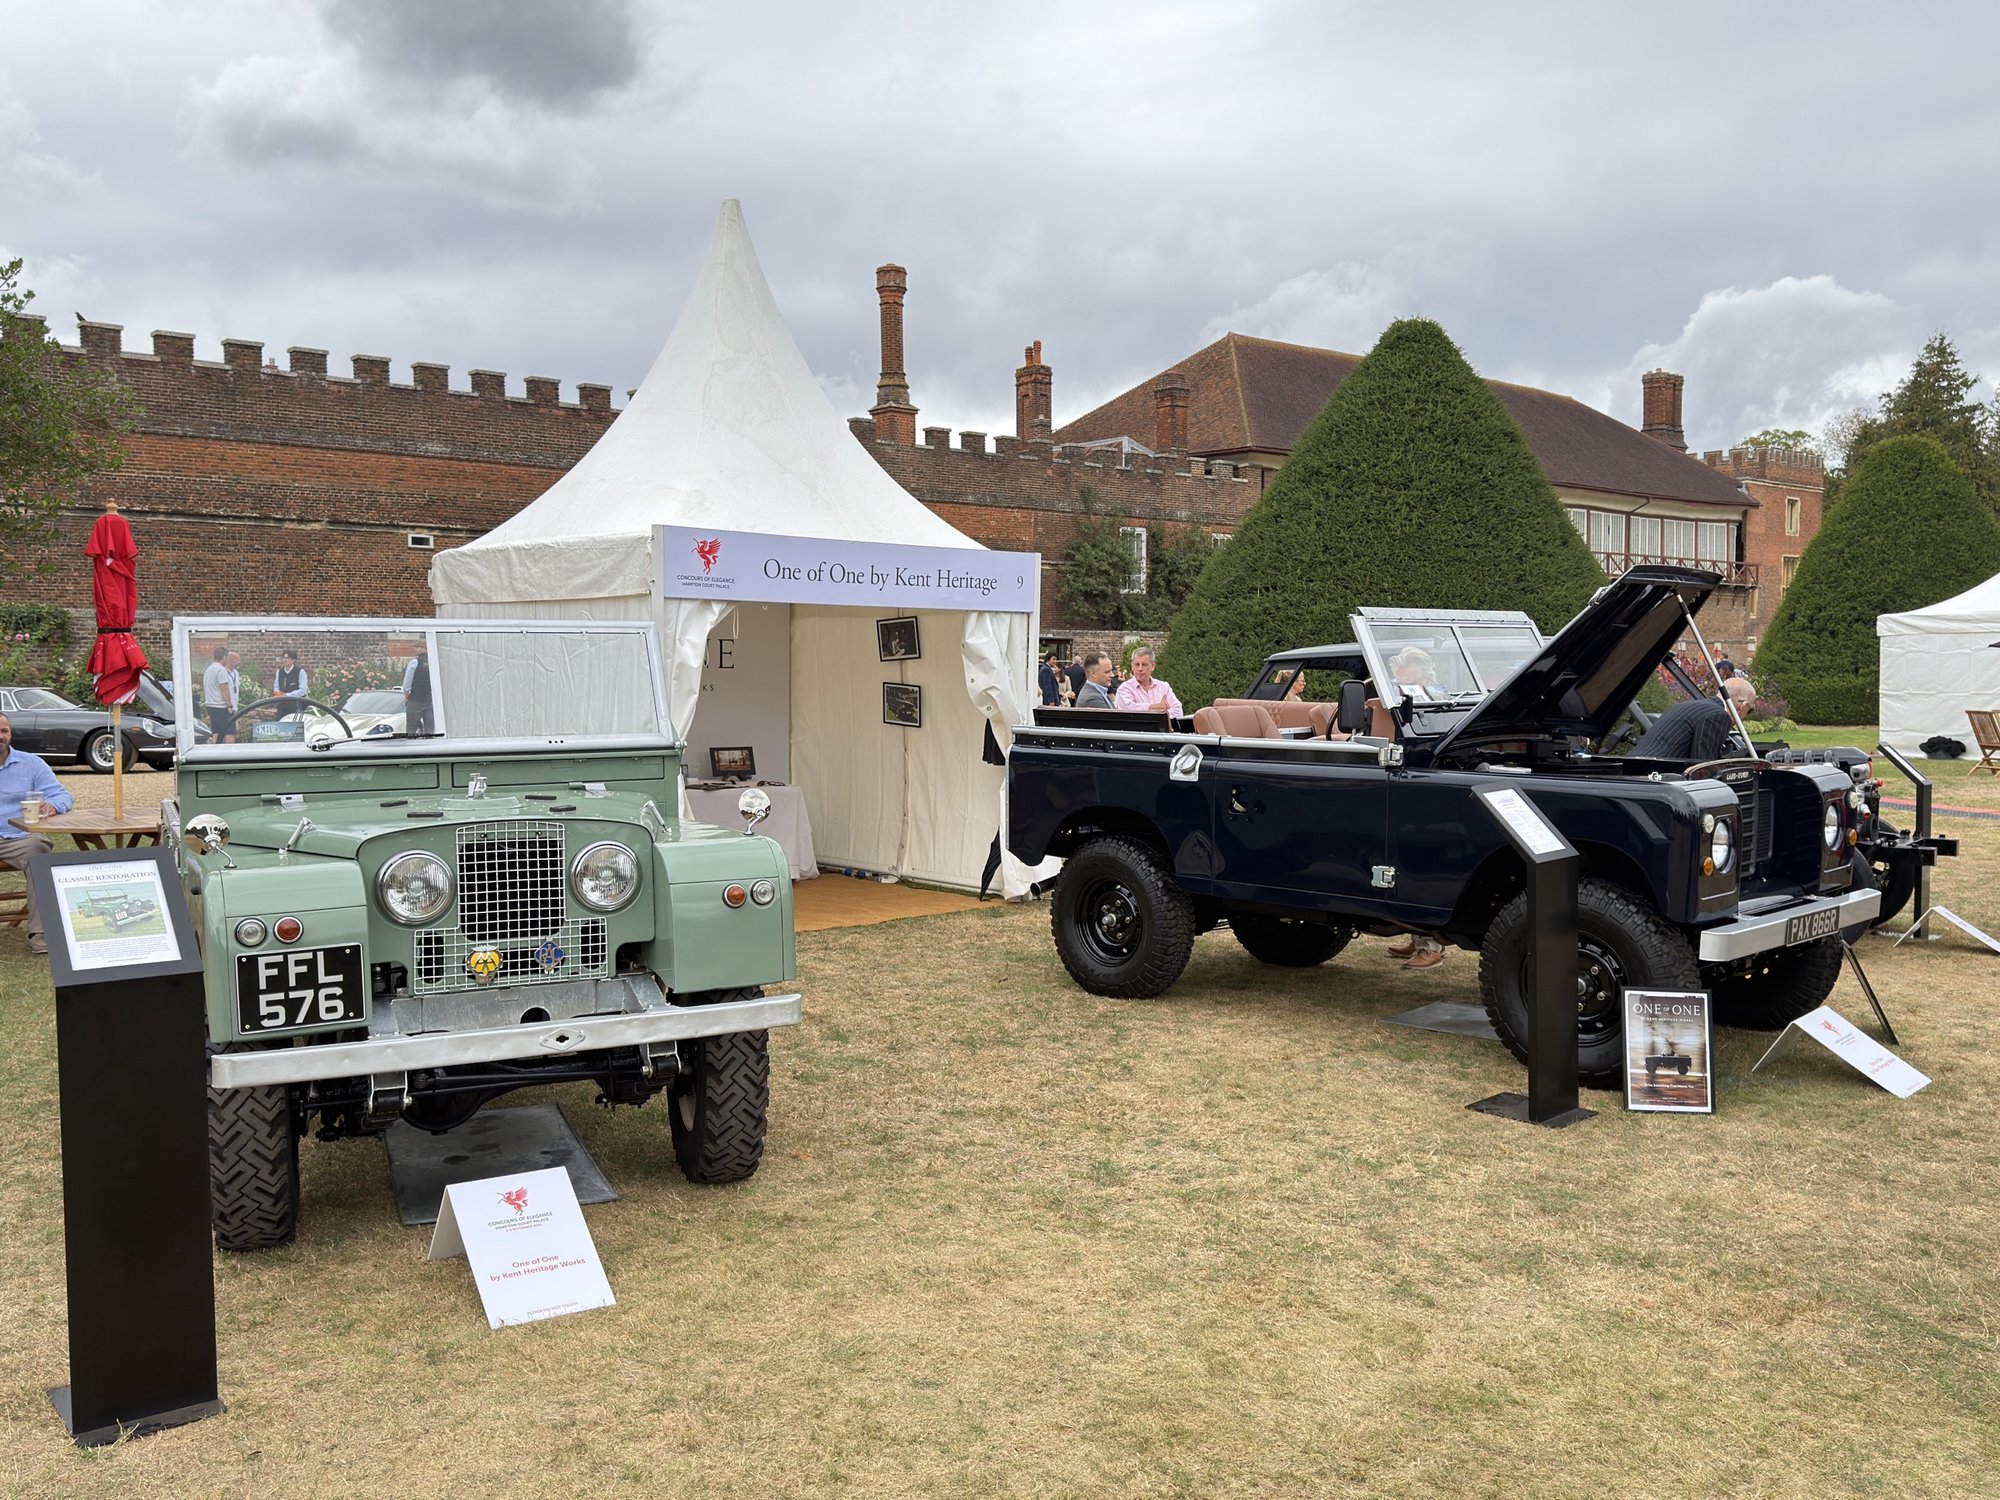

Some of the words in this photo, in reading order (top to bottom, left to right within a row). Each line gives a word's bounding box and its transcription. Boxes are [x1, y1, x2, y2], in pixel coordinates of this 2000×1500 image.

[763, 558, 801, 581] One
[807, 561, 827, 582] of
[829, 563, 865, 585] One
[870, 565, 889, 591] by
[894, 567, 931, 588] Kent
[937, 569, 998, 596] Heritage
[1016, 575, 1024, 590] 9
[58, 874, 95, 883] CLASSIC
[95, 871, 158, 881] RESTORATION
[1791, 915, 1812, 942] PAX
[1811, 909, 1837, 936] 866R
[257, 951, 344, 990] FFL
[258, 987, 344, 1028] 576
[1632, 1003, 1662, 1014] ONE
[1671, 1004, 1701, 1016] ONE
[488, 1217, 518, 1227] CONCOURS
[526, 1211, 553, 1220] ELEGANCE
[518, 1219, 533, 1227] COURT
[490, 1274, 501, 1282] by
[502, 1270, 522, 1279] Kent
[523, 1263, 559, 1275] Heritage
[559, 1257, 586, 1268] Works
[511, 1260, 530, 1269] One
[541, 1255, 560, 1263] One
